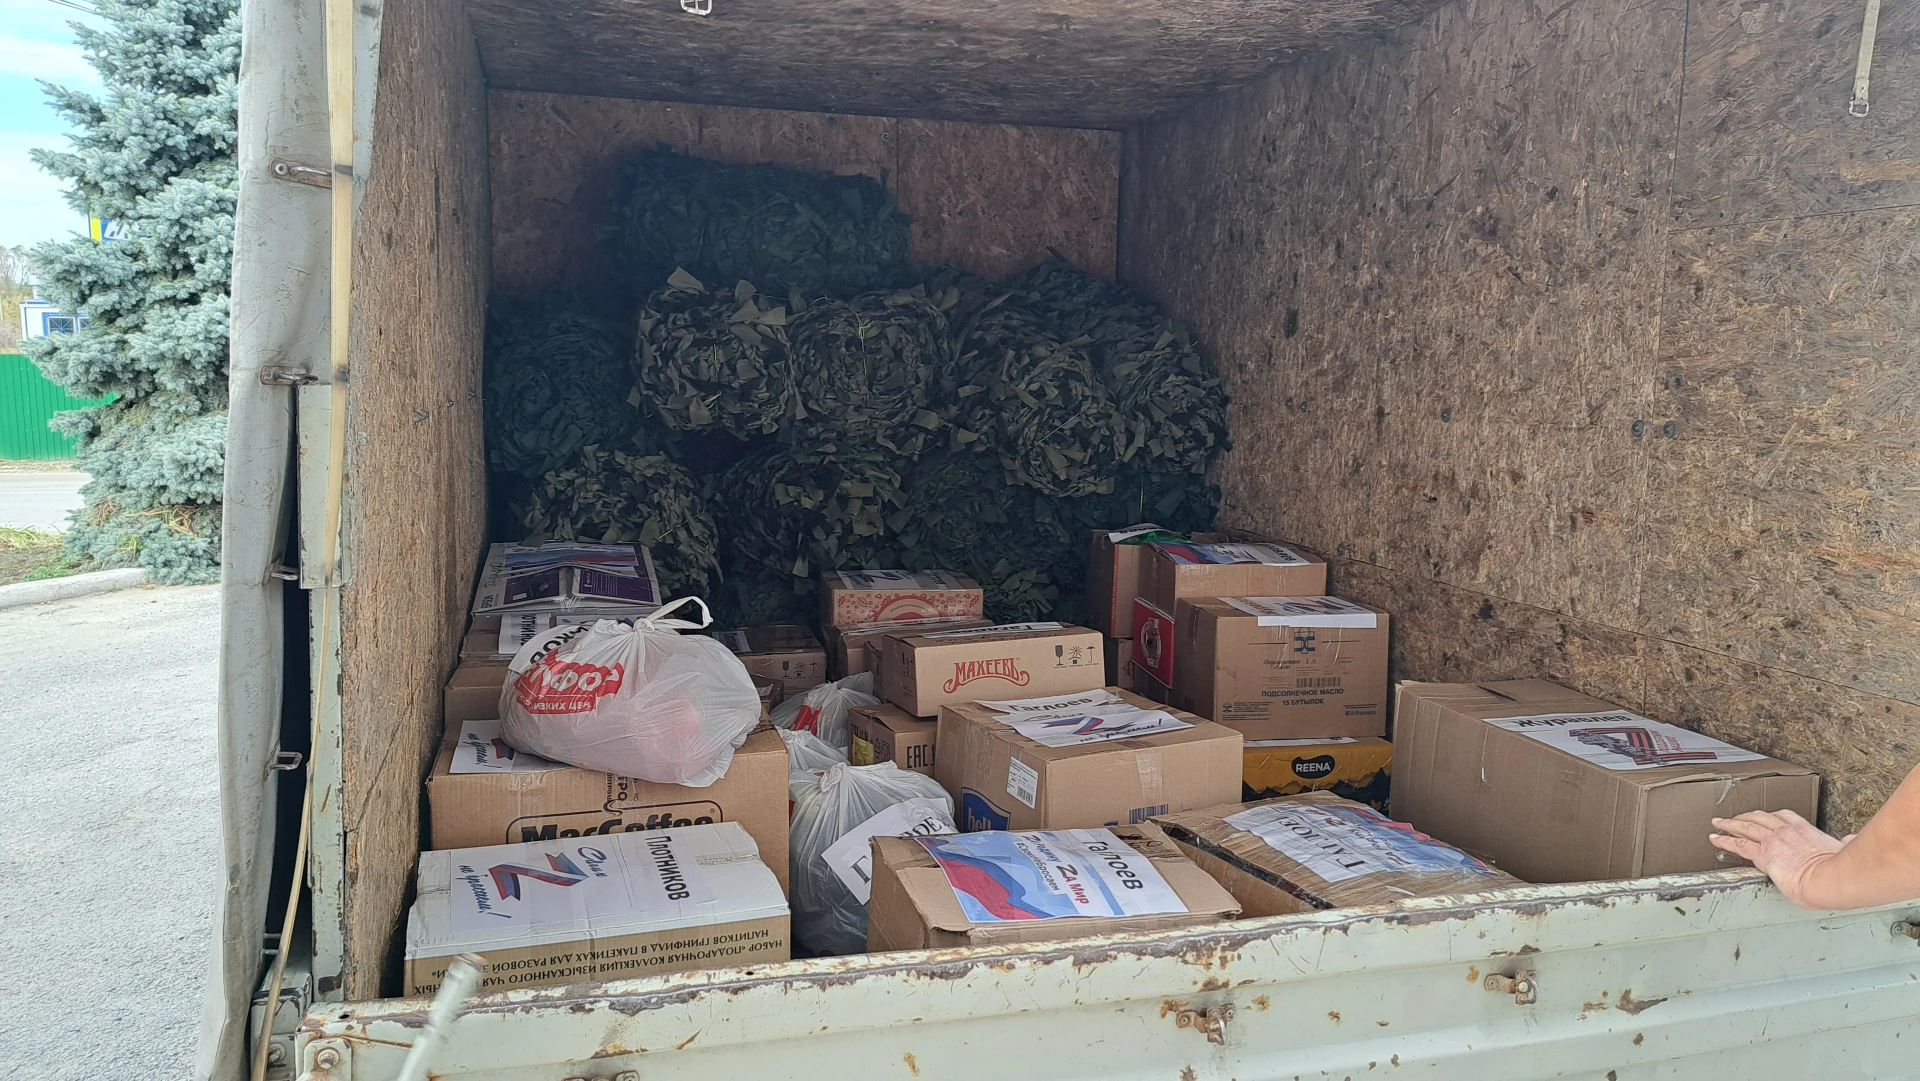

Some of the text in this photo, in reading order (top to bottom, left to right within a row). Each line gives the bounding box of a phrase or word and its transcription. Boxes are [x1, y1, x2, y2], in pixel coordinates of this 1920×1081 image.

[1261, 689, 1319, 698] ПОДСОЛНЕЧНОЕ
[1008, 698, 1093, 712] Гаглоев
[1291, 698, 1325, 706] БУТЫЛОК
[1512, 714, 1633, 727] Журавлев
[1295, 762, 1331, 773] REENA
[644, 835, 690, 900] Плотников
[1069, 883, 1090, 905] Мир
[713, 929, 769, 945] НАПИТКОВ
[641, 946, 647, 954] В
[650, 937, 710, 952] ГРИНФИЛД
[749, 939, 782, 953] НАБОР
[550, 953, 574, 966] ДЛЯ
[575, 945, 638, 962] ПАКЕТИКАХ
[667, 945, 747, 964] «ПОДАРОЧНАЯ
[492, 957, 547, 975] РАЗОВОЙ
[599, 955, 665, 973] КОЛЛЕКЦИЯ
[508, 964, 597, 984] ИЗЫСКАННОГО
[482, 978, 505, 987] ЧАЯ
